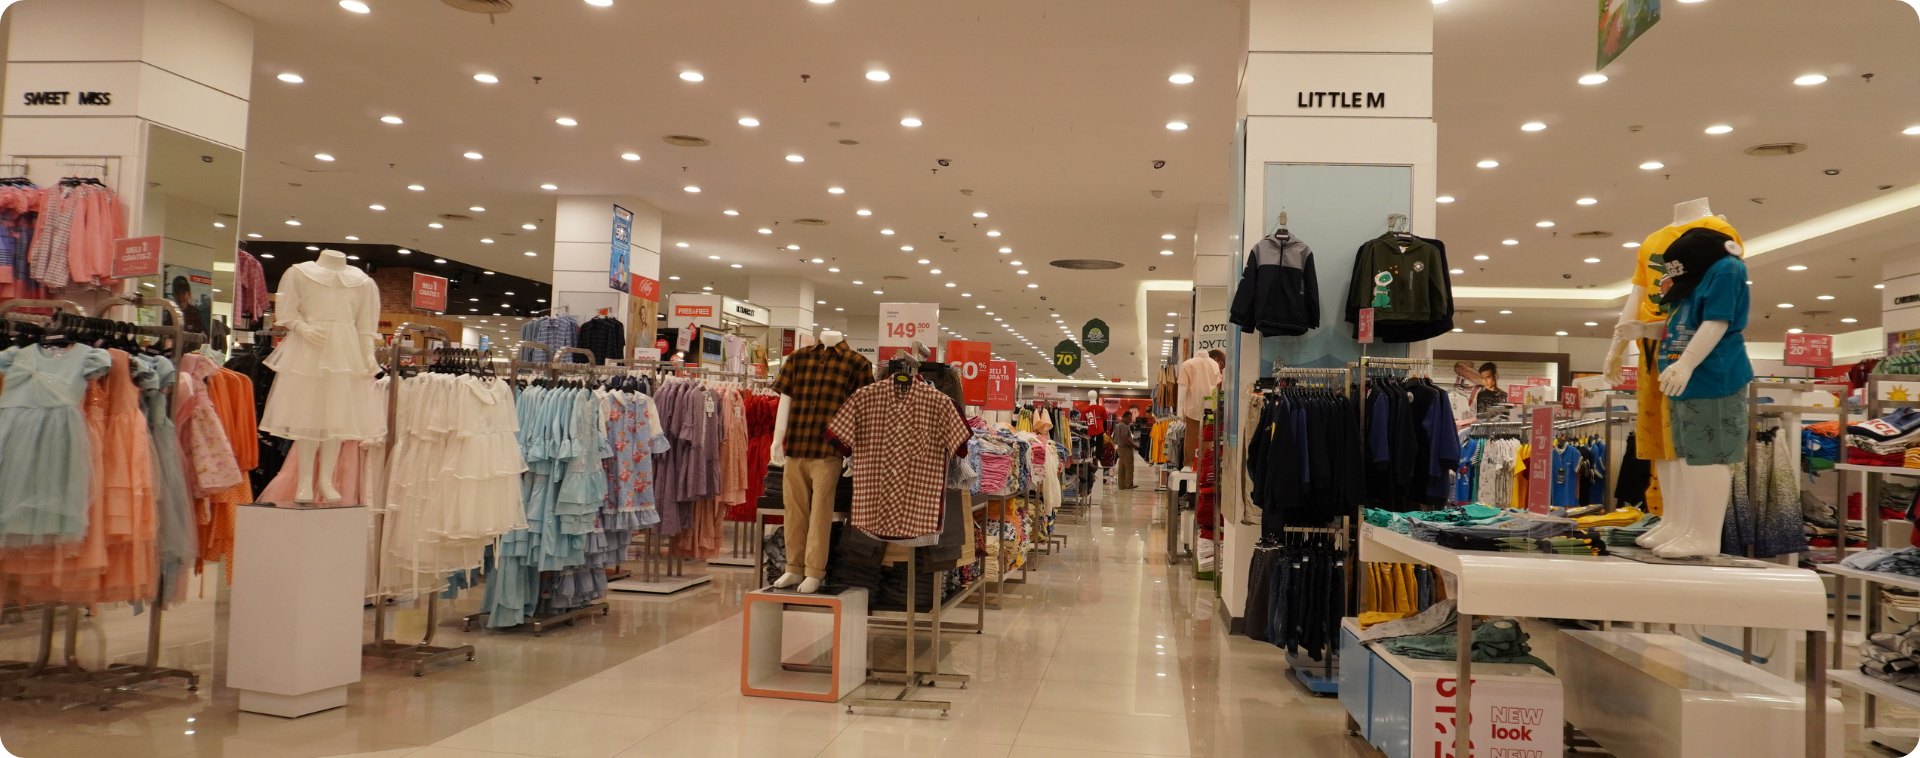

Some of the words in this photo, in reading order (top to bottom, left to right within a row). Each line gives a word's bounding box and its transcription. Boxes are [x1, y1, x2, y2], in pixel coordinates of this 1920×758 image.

[23, 91, 70, 106] SWEET
[78, 91, 111, 106] MISS
[1298, 91, 1362, 108] LITTLE
[1366, 92, 1385, 108] M
[126, 246, 141, 254] BELI
[141, 242, 148, 252] 1
[122, 253, 146, 261] GRATIS
[1056, 354, 1077, 365] 70%
[995, 380, 1000, 392] 1
[1491, 706, 1544, 725] NEW
[1491, 724, 1532, 741] look
